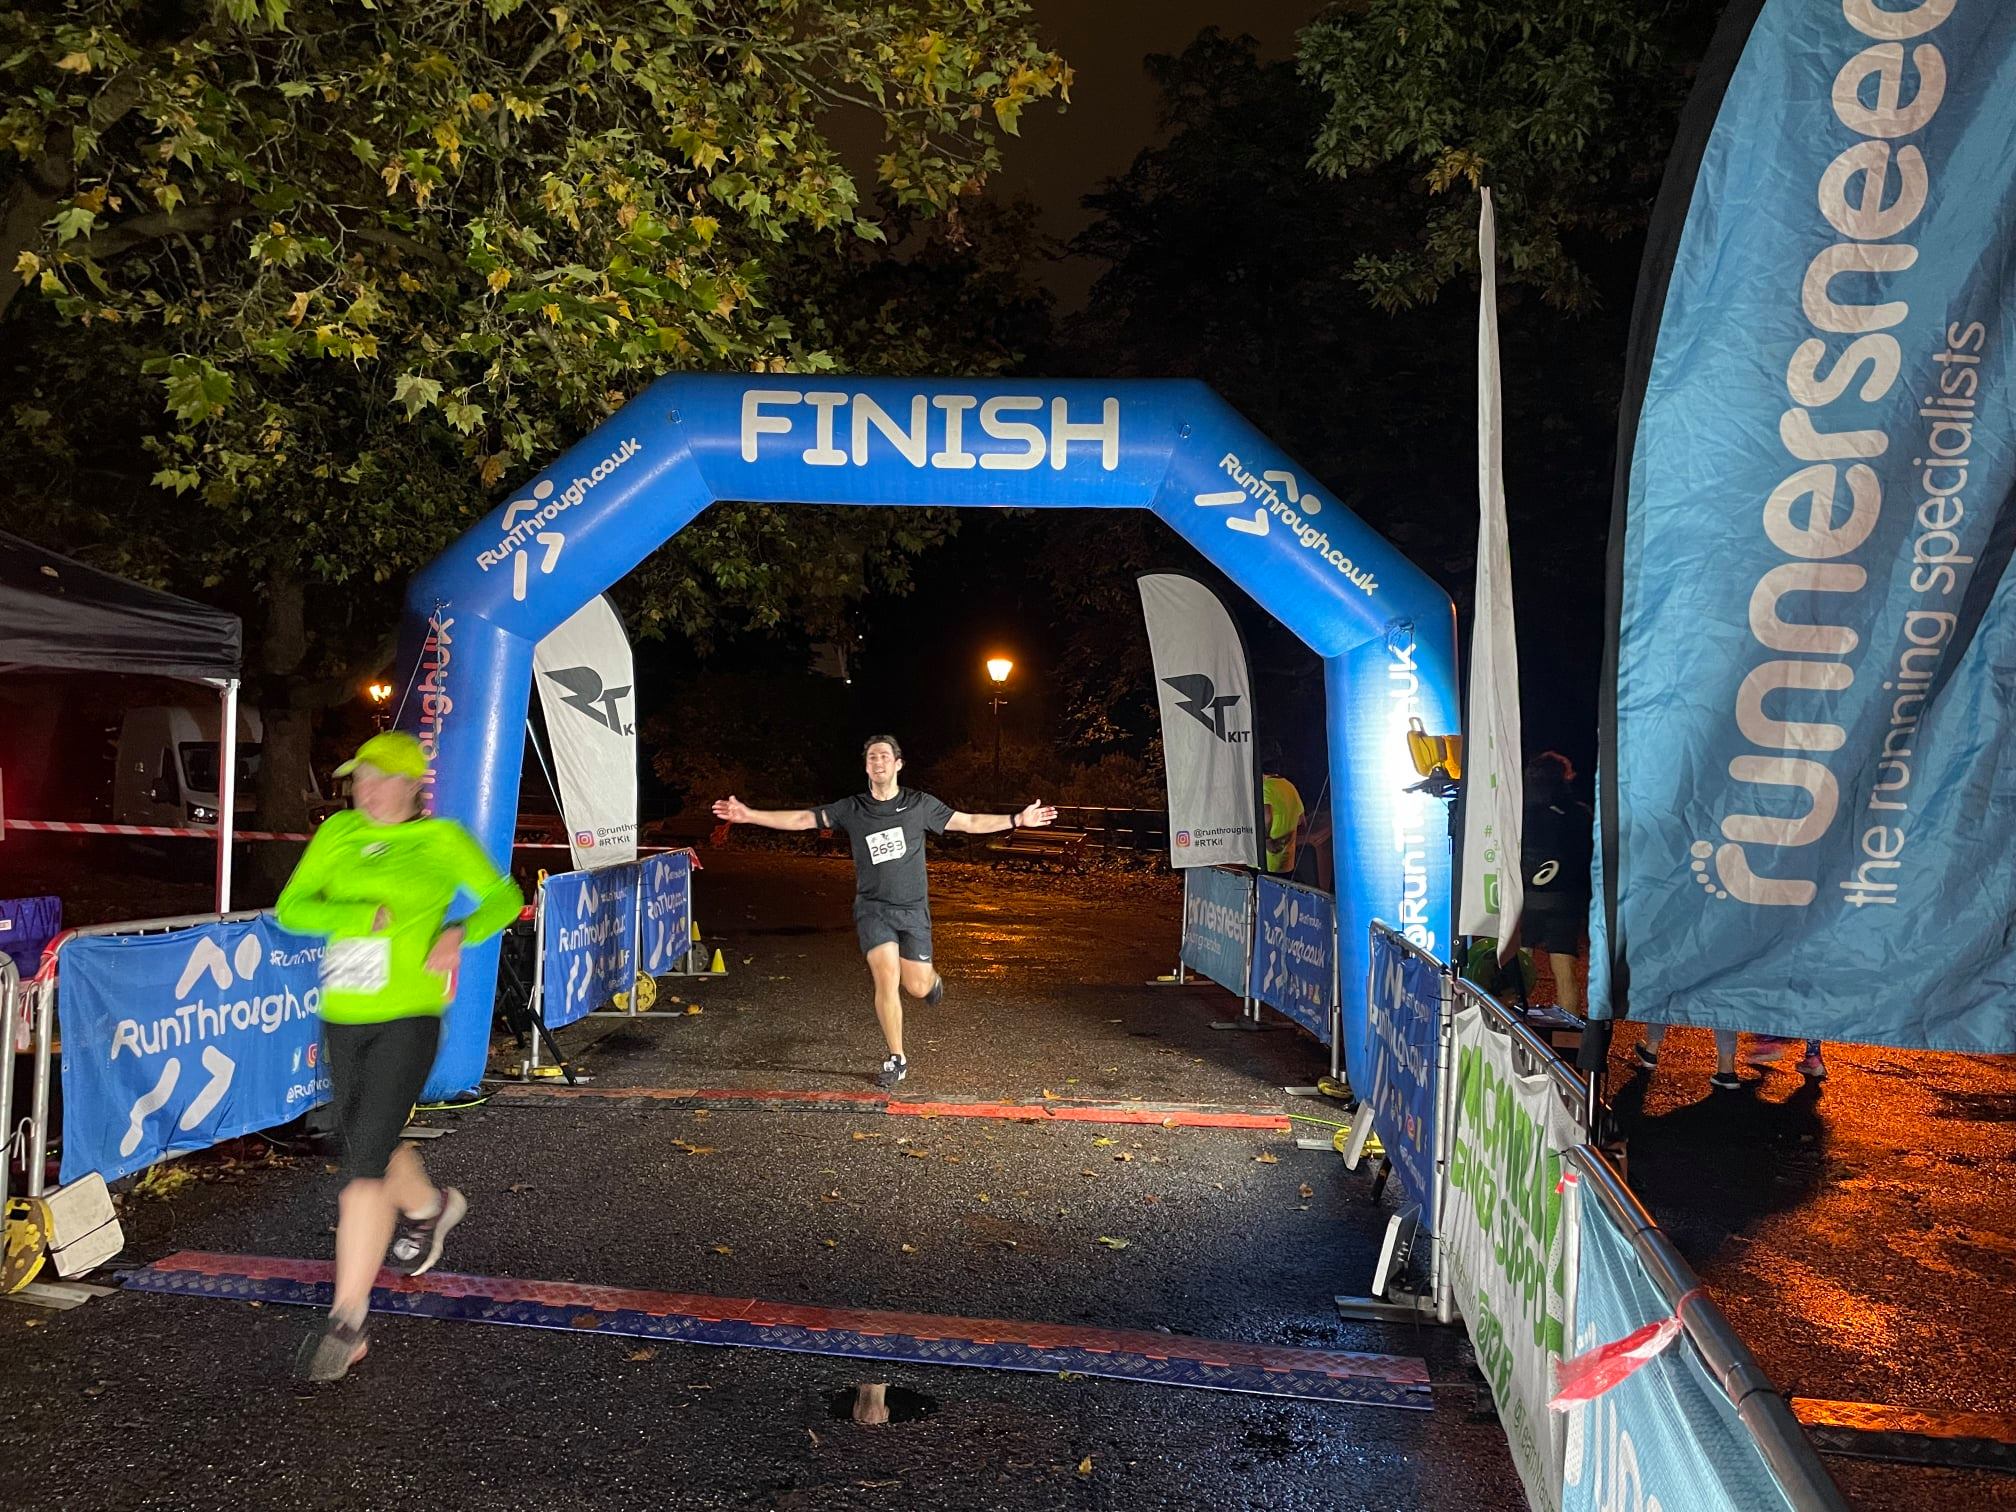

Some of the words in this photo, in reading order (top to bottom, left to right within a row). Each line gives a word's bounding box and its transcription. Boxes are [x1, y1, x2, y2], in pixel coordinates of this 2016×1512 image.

[741, 390, 1119, 471] FINISH
[1911, 320, 1986, 595] specialists
[476, 437, 642, 571] RunThrough.co.uk
[1219, 453, 1379, 596] RunThrough.co.uk
[1228, 731, 1251, 744] KIT
[1869, 610, 1957, 811] running
[871, 840, 904, 857] 2693
[1840, 825, 1905, 907] the
